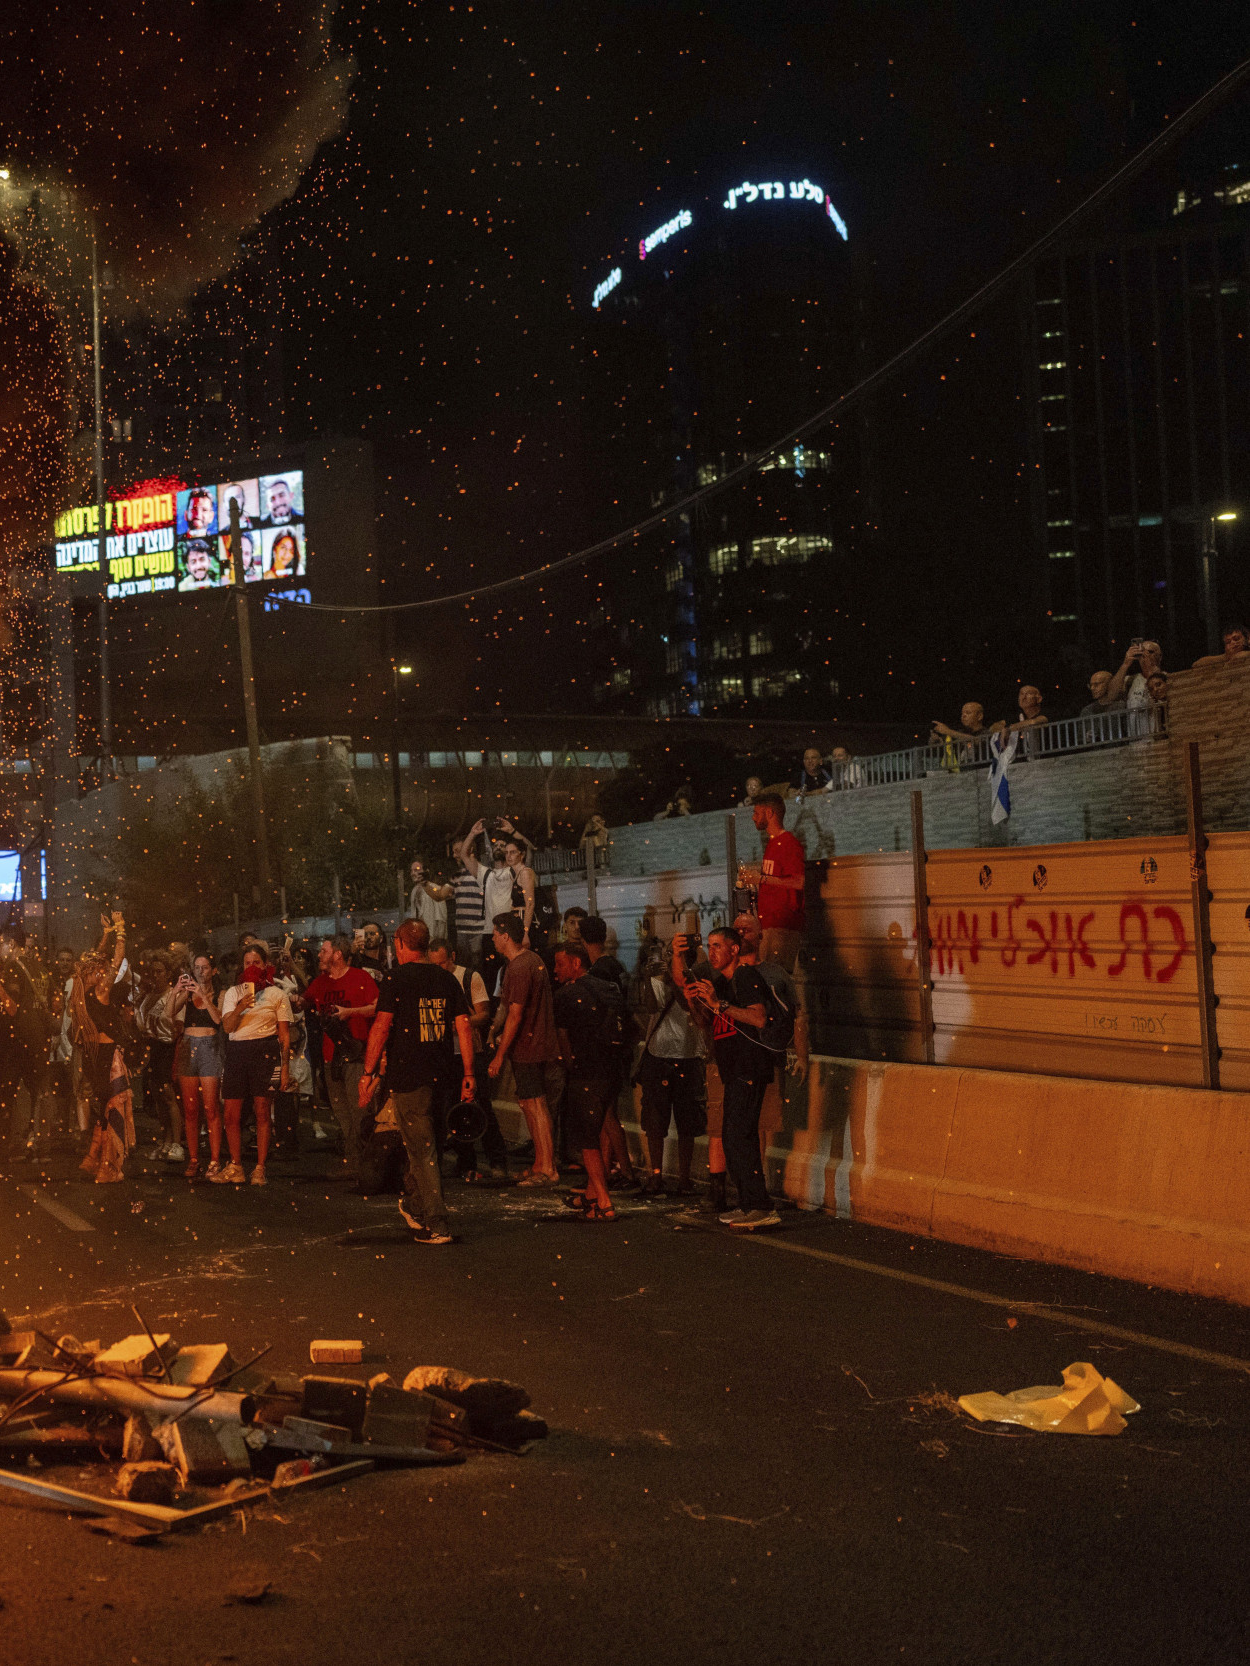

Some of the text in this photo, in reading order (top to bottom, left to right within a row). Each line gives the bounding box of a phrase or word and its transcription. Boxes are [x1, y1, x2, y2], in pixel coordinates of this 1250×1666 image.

[789, 179, 824, 204] סלע
[644, 209, 693, 252] semperis
[105, 534, 126, 559] את
[126, 527, 174, 557] עוצרים
[109, 550, 175, 583] עושים סוף
[1108, 900, 1187, 983] כת
